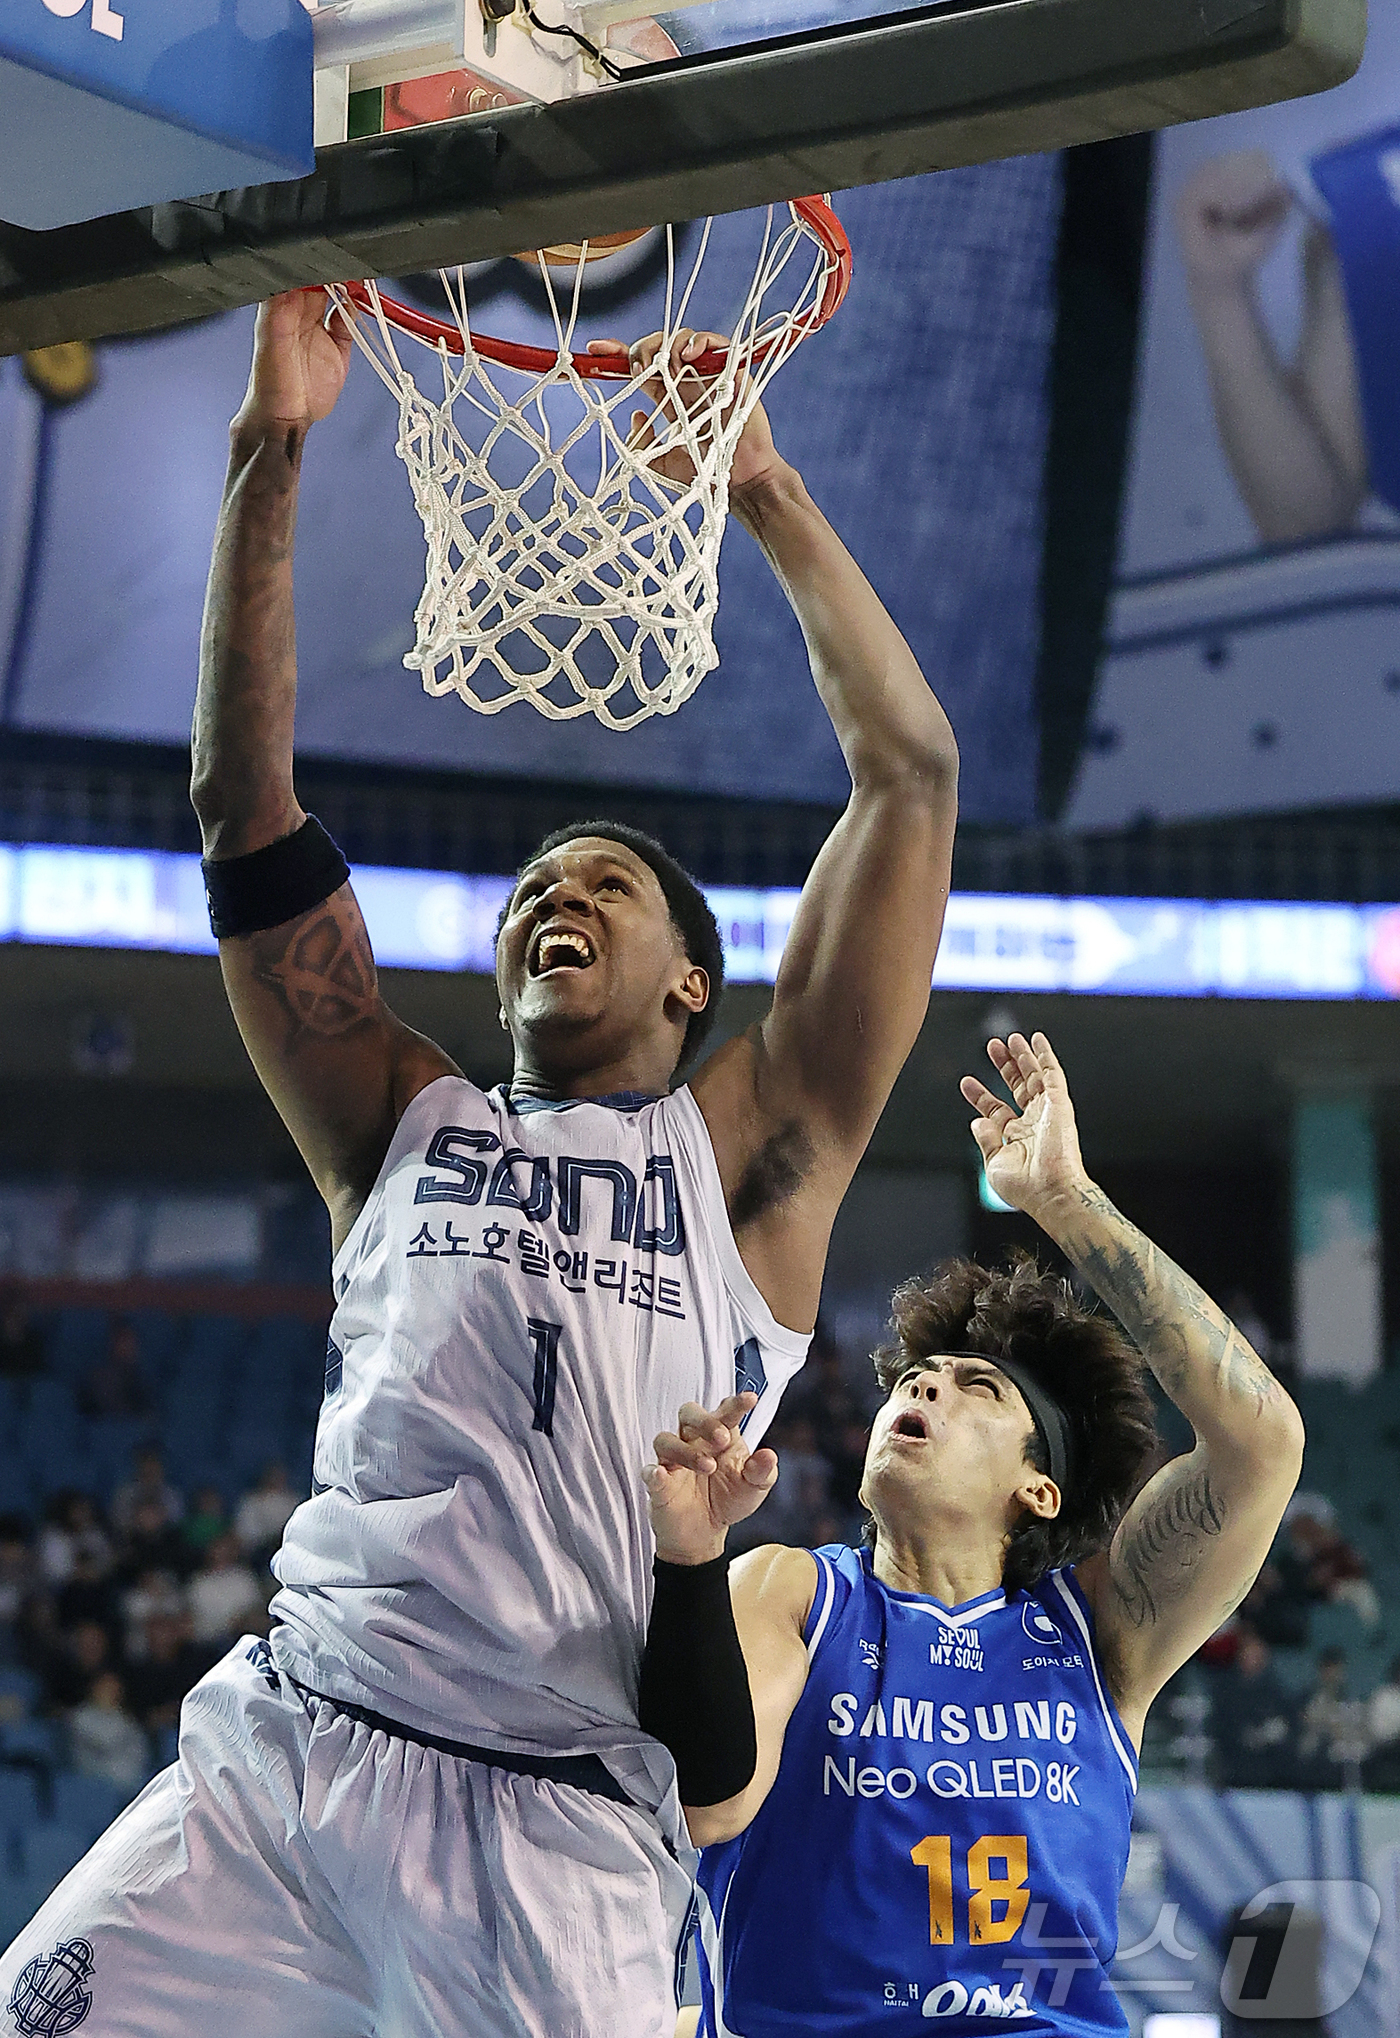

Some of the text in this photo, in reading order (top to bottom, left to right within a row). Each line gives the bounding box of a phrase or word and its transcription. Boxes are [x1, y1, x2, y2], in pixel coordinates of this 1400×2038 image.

[406, 1221, 686, 1319] 소노호텔앤리조트
[526, 1316, 562, 1437] 1
[937, 1626, 981, 1649] SEOUL
[954, 1646, 985, 1672] SOUL
[827, 1692, 1078, 1745] SAMSUNG
[823, 1755, 1081, 1806] Neo QLED 8K
[910, 1835, 1031, 1946] 18
